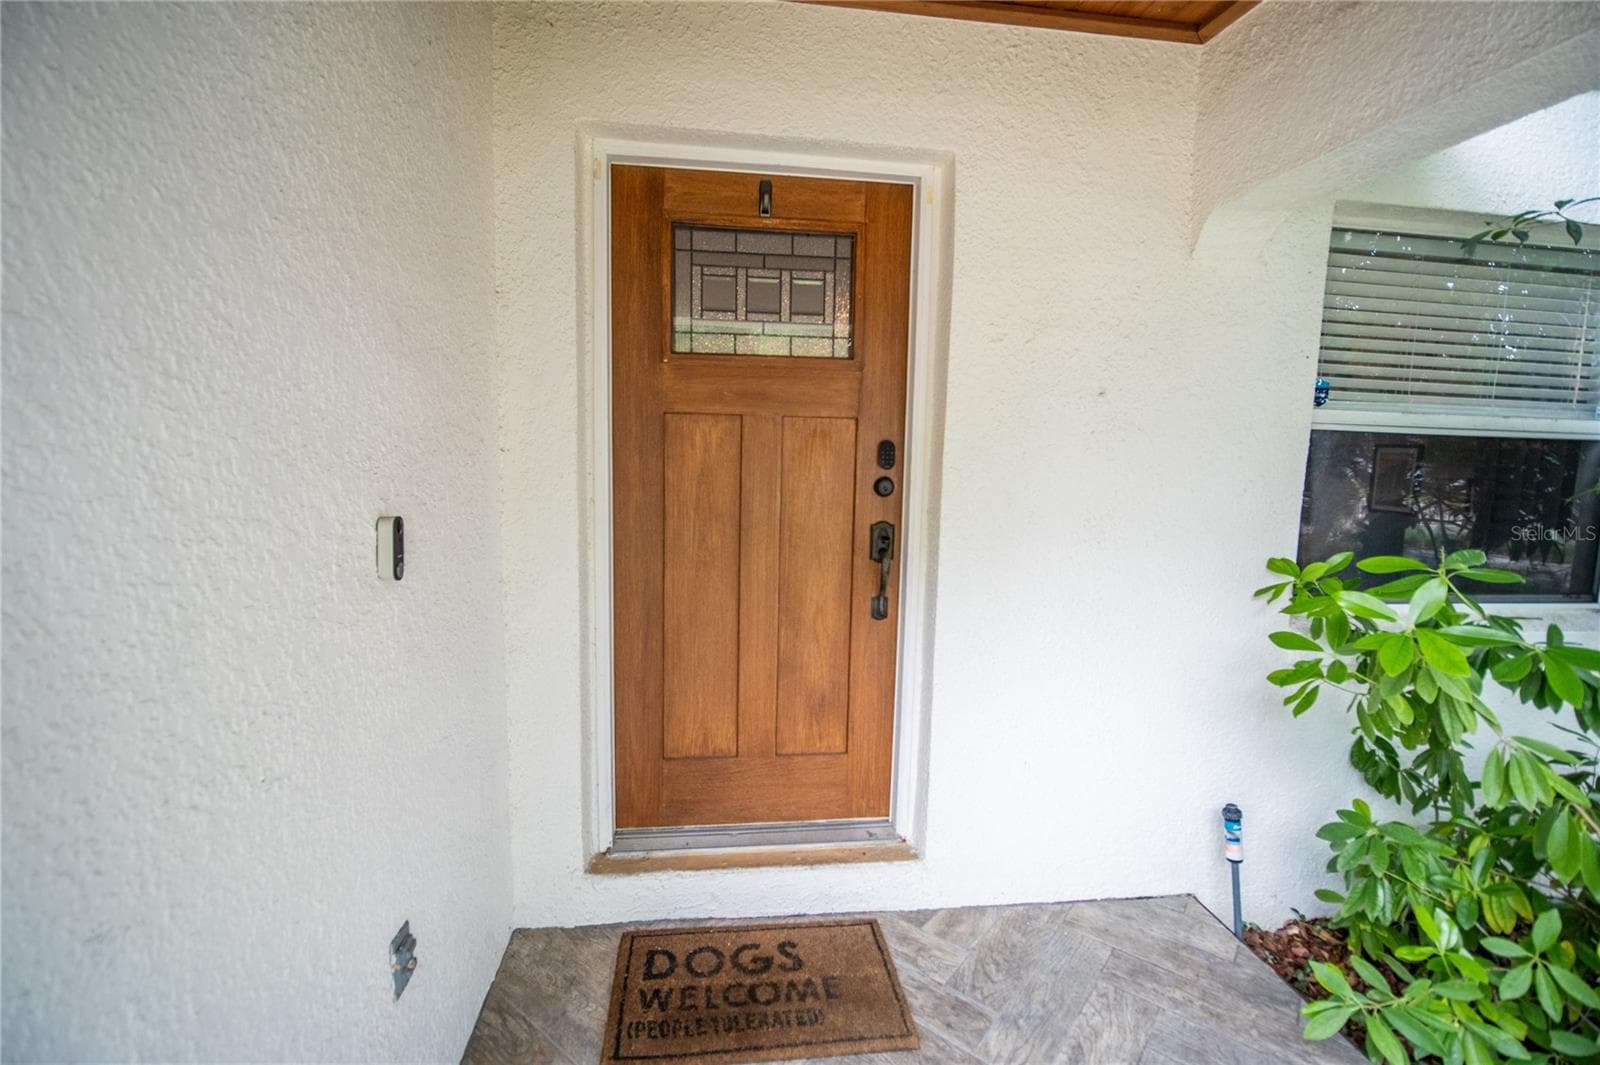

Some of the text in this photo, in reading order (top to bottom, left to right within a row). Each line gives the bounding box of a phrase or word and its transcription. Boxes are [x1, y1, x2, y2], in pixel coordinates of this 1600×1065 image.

[642, 940, 803, 980] DOGS
[639, 976, 843, 1013] WELCOME
[627, 1017, 706, 1040] (PEOPLE
